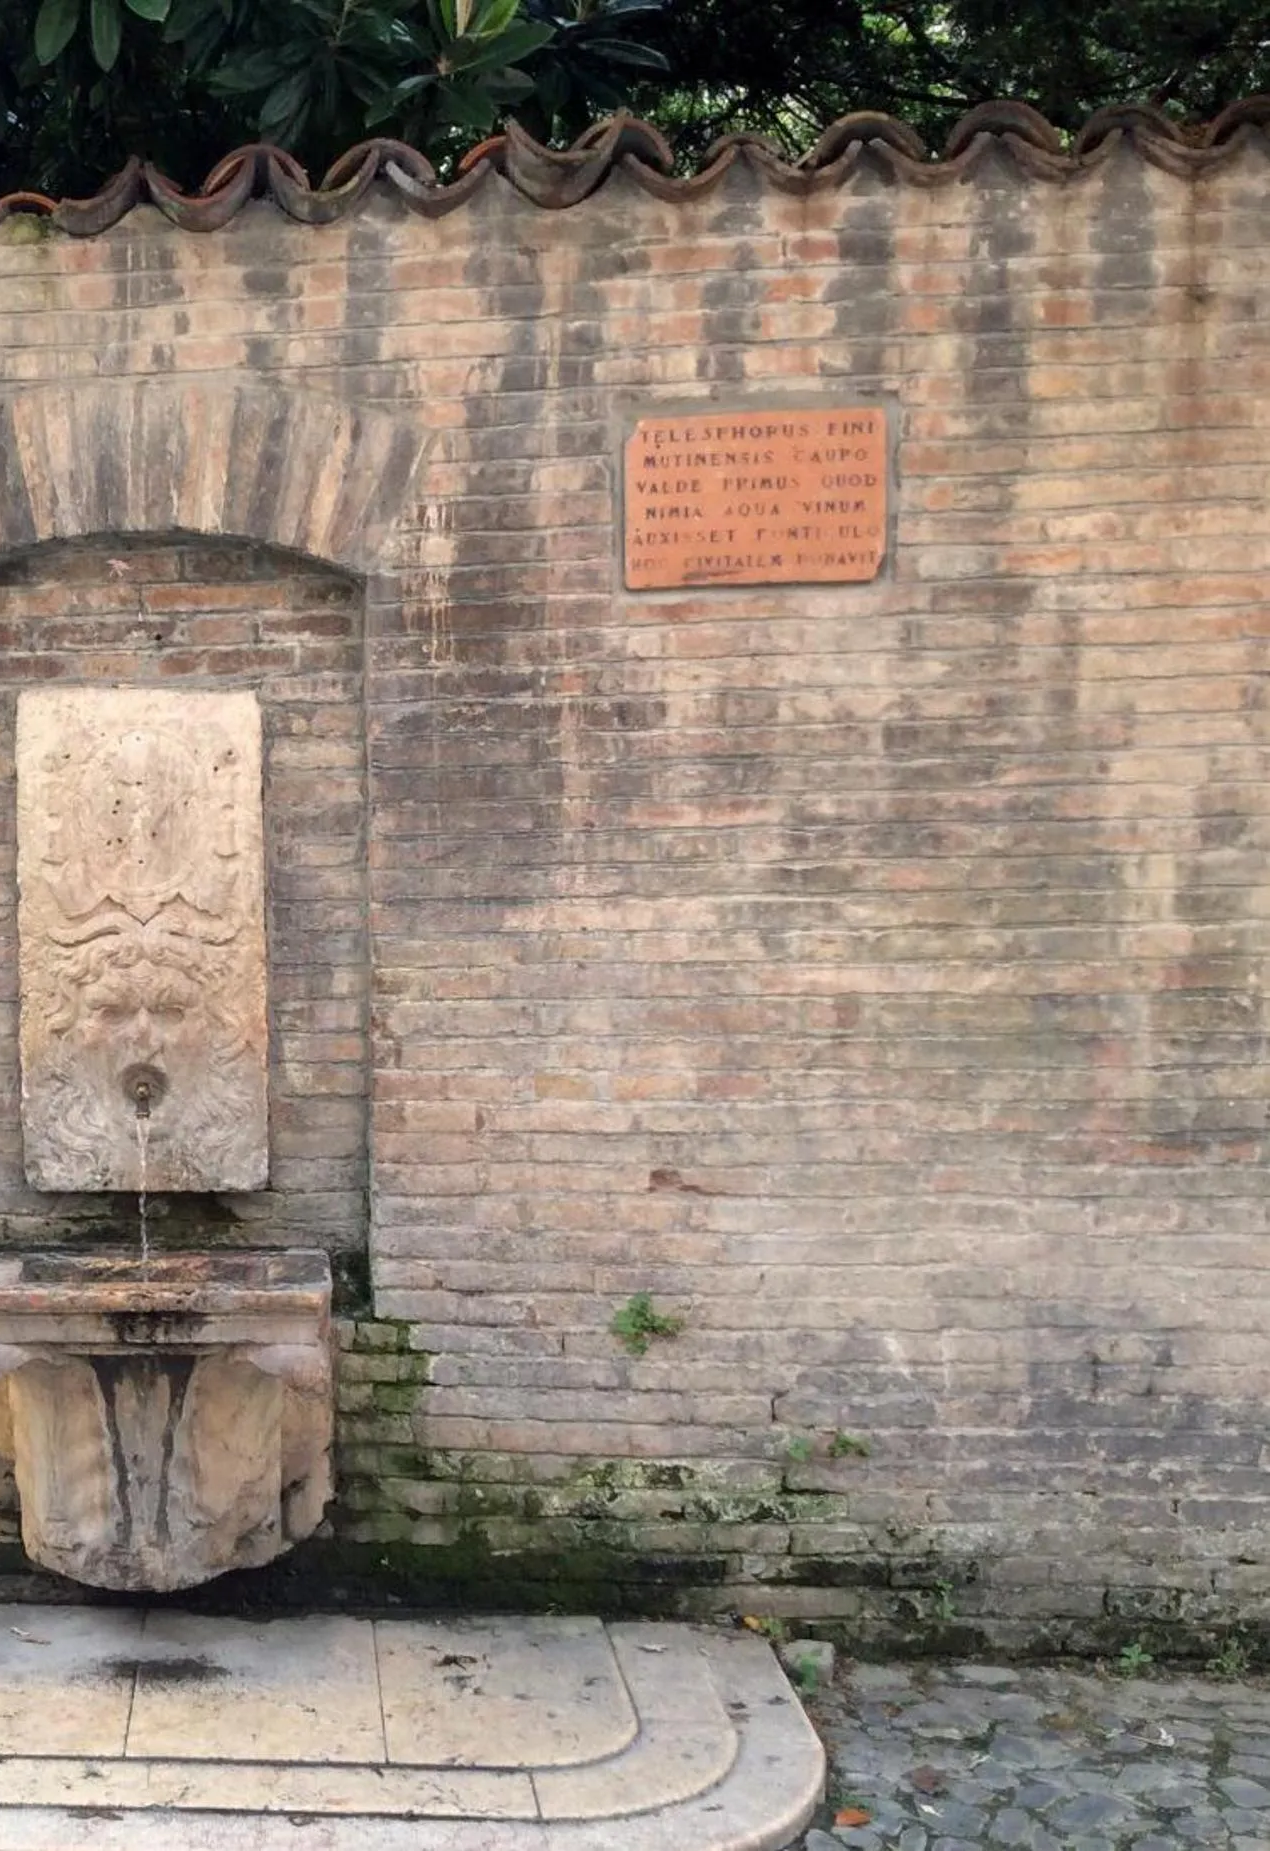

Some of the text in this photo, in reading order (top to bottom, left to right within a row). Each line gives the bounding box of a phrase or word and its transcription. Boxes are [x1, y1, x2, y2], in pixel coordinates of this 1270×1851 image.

[827, 420, 875, 437] FINI
[643, 451, 775, 468] MUTINENSIS
[636, 479, 702, 495] VALDE
[821, 473, 877, 489] QUOD
[645, 500, 866, 521] NIMIA AQUA VINUM
[756, 526, 880, 542] FONTIULO
